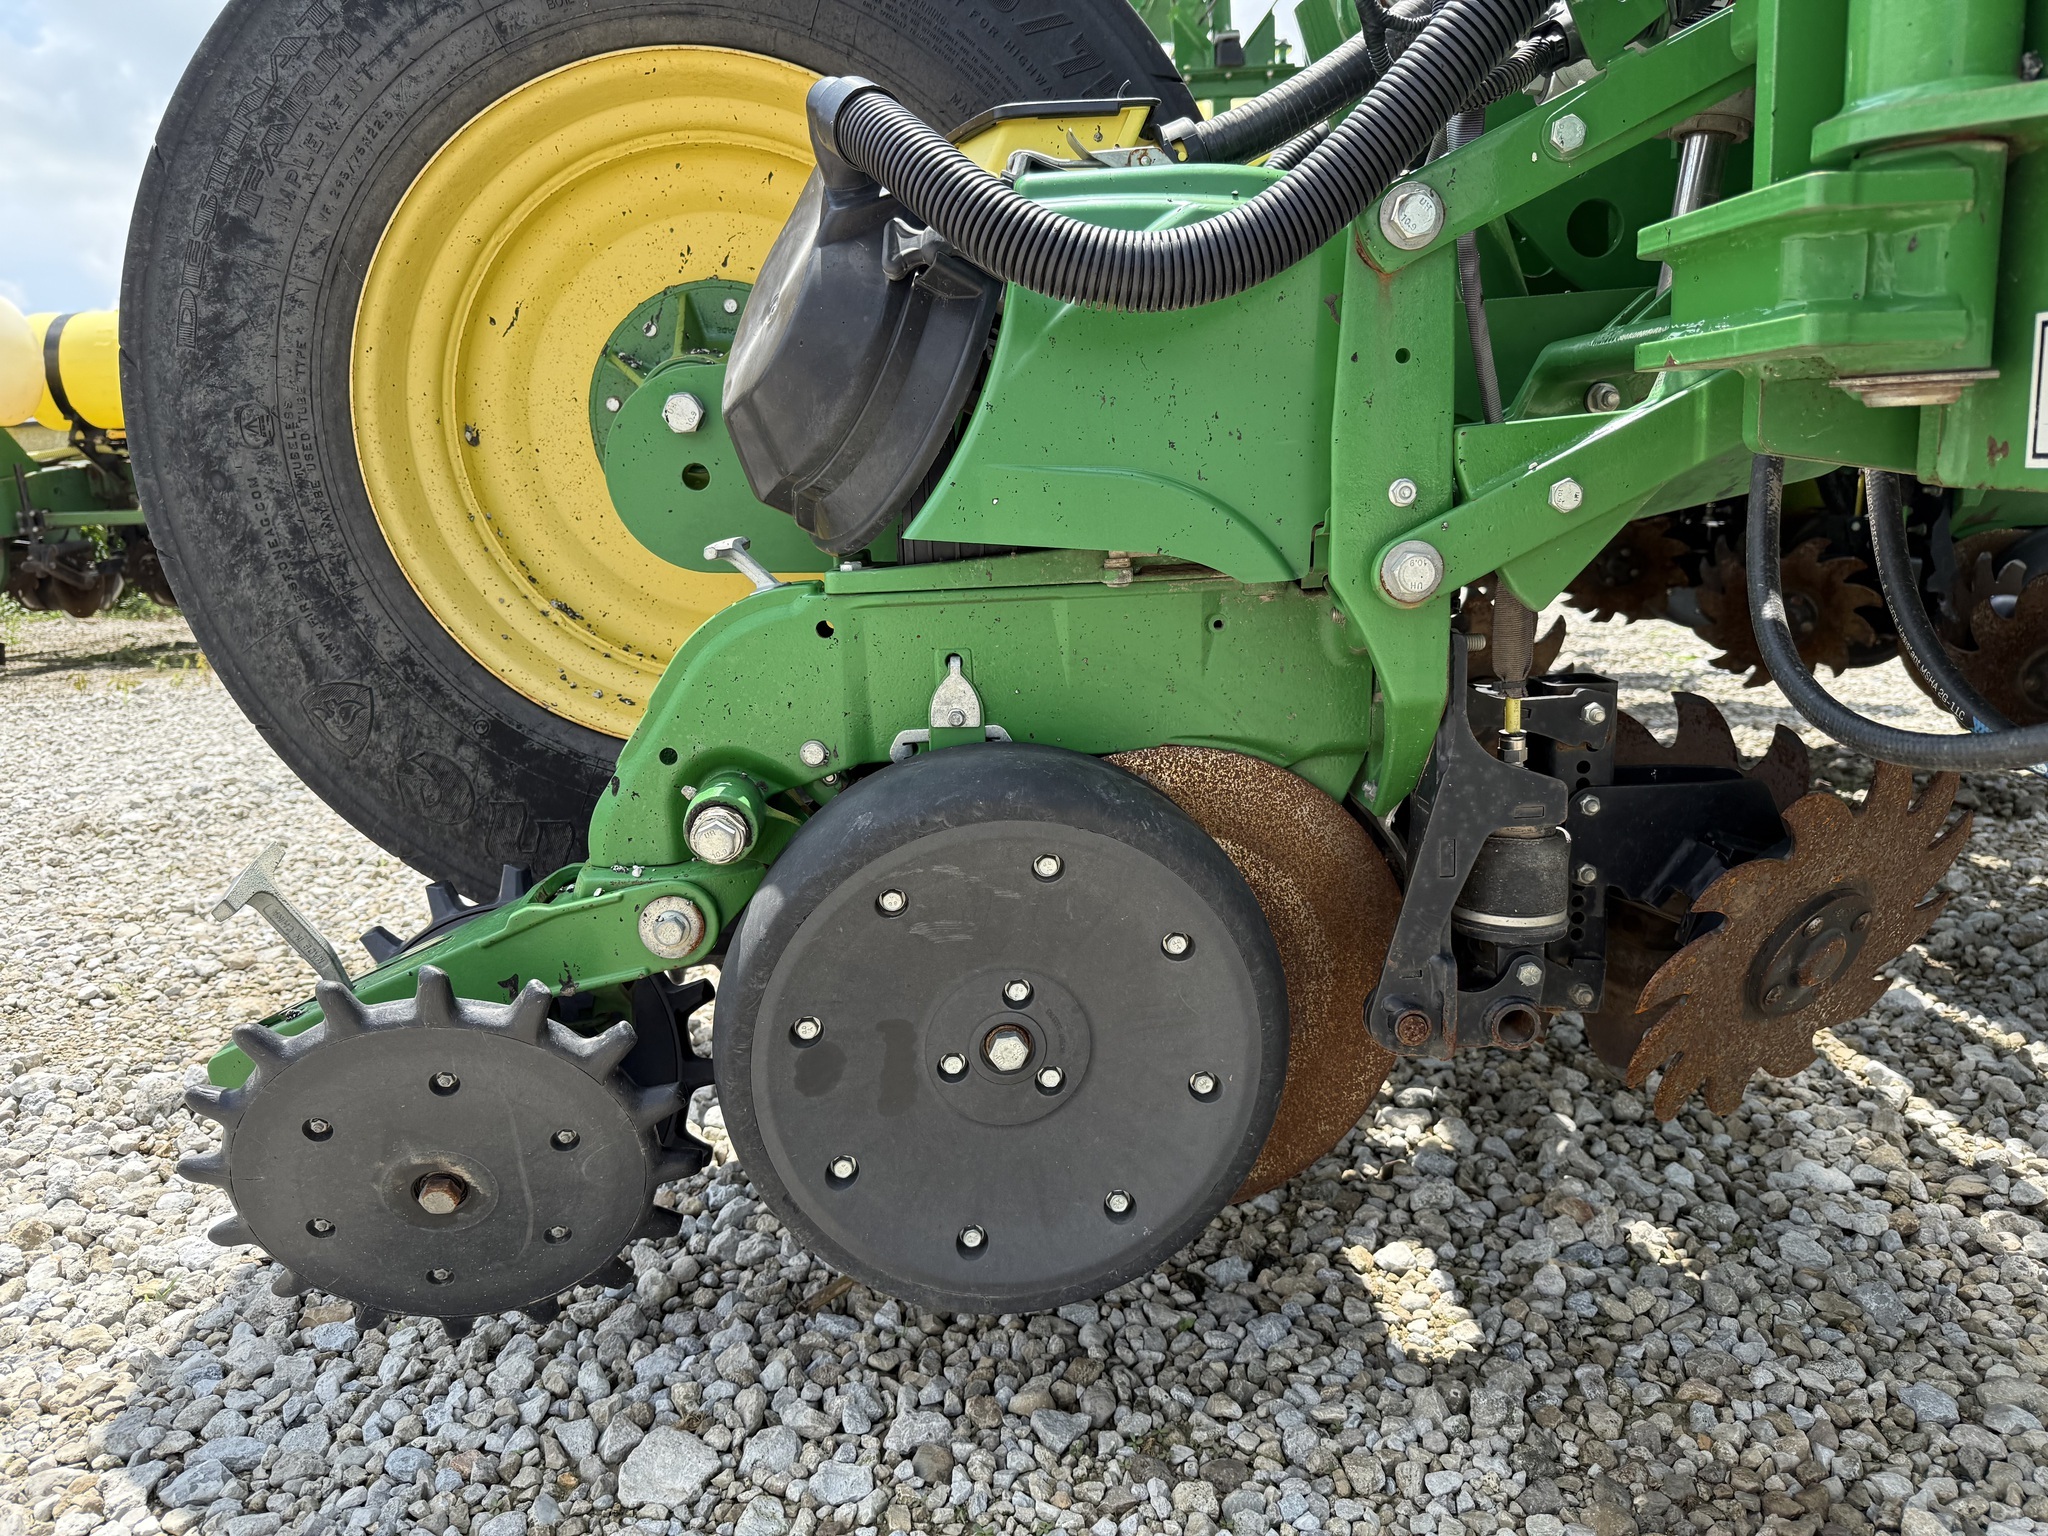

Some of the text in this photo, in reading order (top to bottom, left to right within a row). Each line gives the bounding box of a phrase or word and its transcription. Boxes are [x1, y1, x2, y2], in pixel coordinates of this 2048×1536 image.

[967, 6, 1002, 40] FOR
[233, 28, 361, 218] FARM
[266, 62, 374, 226] IMPLEMENT
[176, 0, 347, 350] DESTINAT
[294, 339, 307, 376] TYPE
[299, 431, 317, 472] USED
[308, 478, 325, 501] BE
[1919, 666, 1939, 691] MSHA
[1937, 687, 1966, 721] 2G-11C
